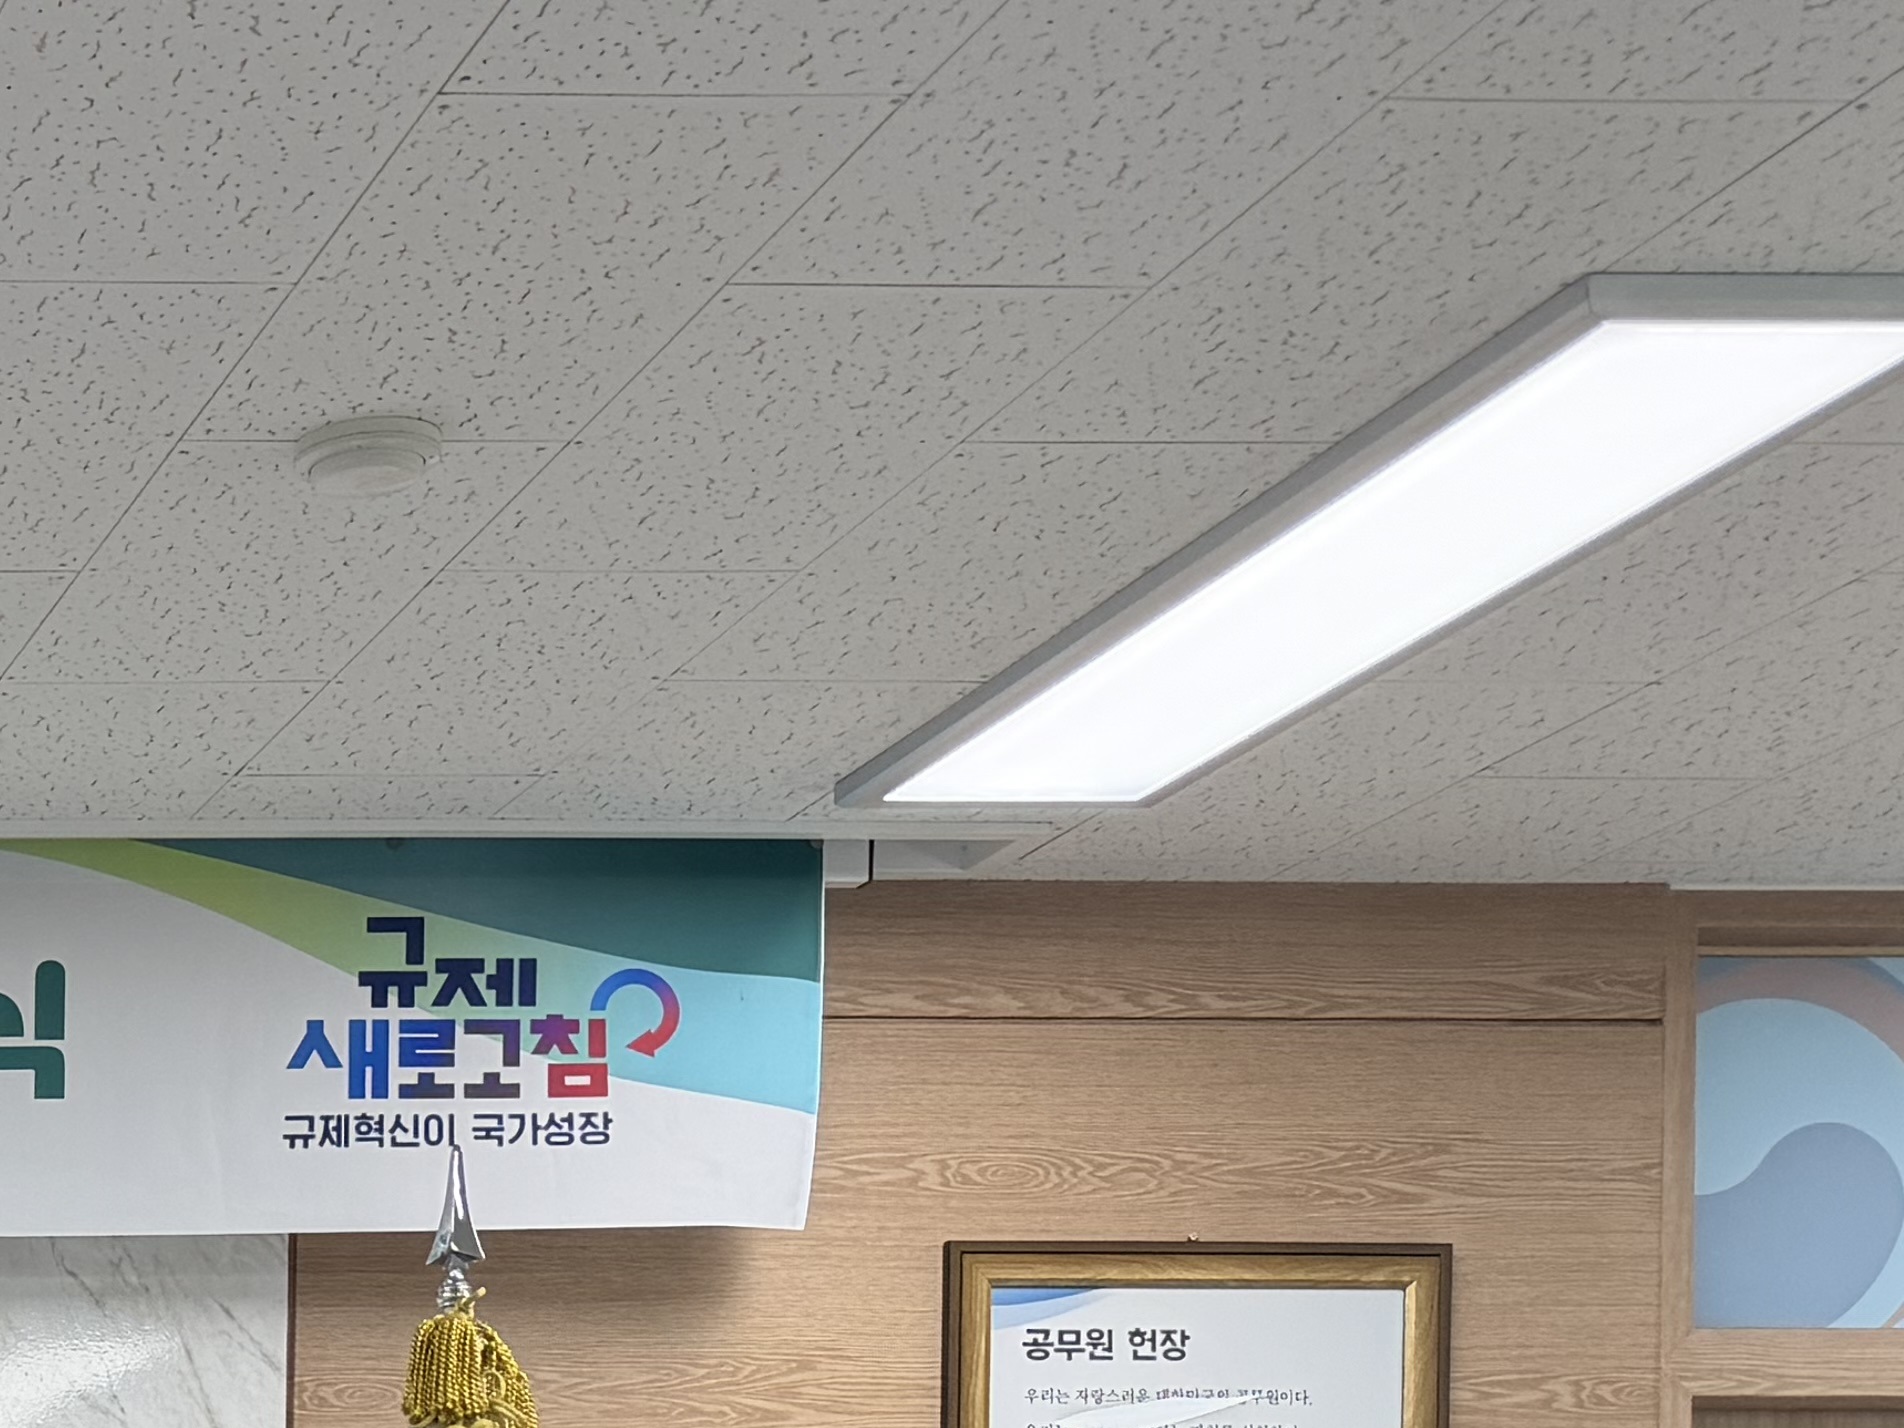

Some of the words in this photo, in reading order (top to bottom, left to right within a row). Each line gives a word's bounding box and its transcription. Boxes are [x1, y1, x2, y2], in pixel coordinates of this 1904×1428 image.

[358, 917, 537, 1008] 규제
[286, 1014, 608, 1099] 새로고침
[282, 1112, 461, 1148] 규제혁신이
[471, 1111, 614, 1148] 국가성장
[1021, 1328, 1114, 1362] 공무원
[1127, 1327, 1191, 1362] 헌장
[1024, 1387, 1070, 1405] 우리는
[1075, 1387, 1151, 1407] 자랑스러운
